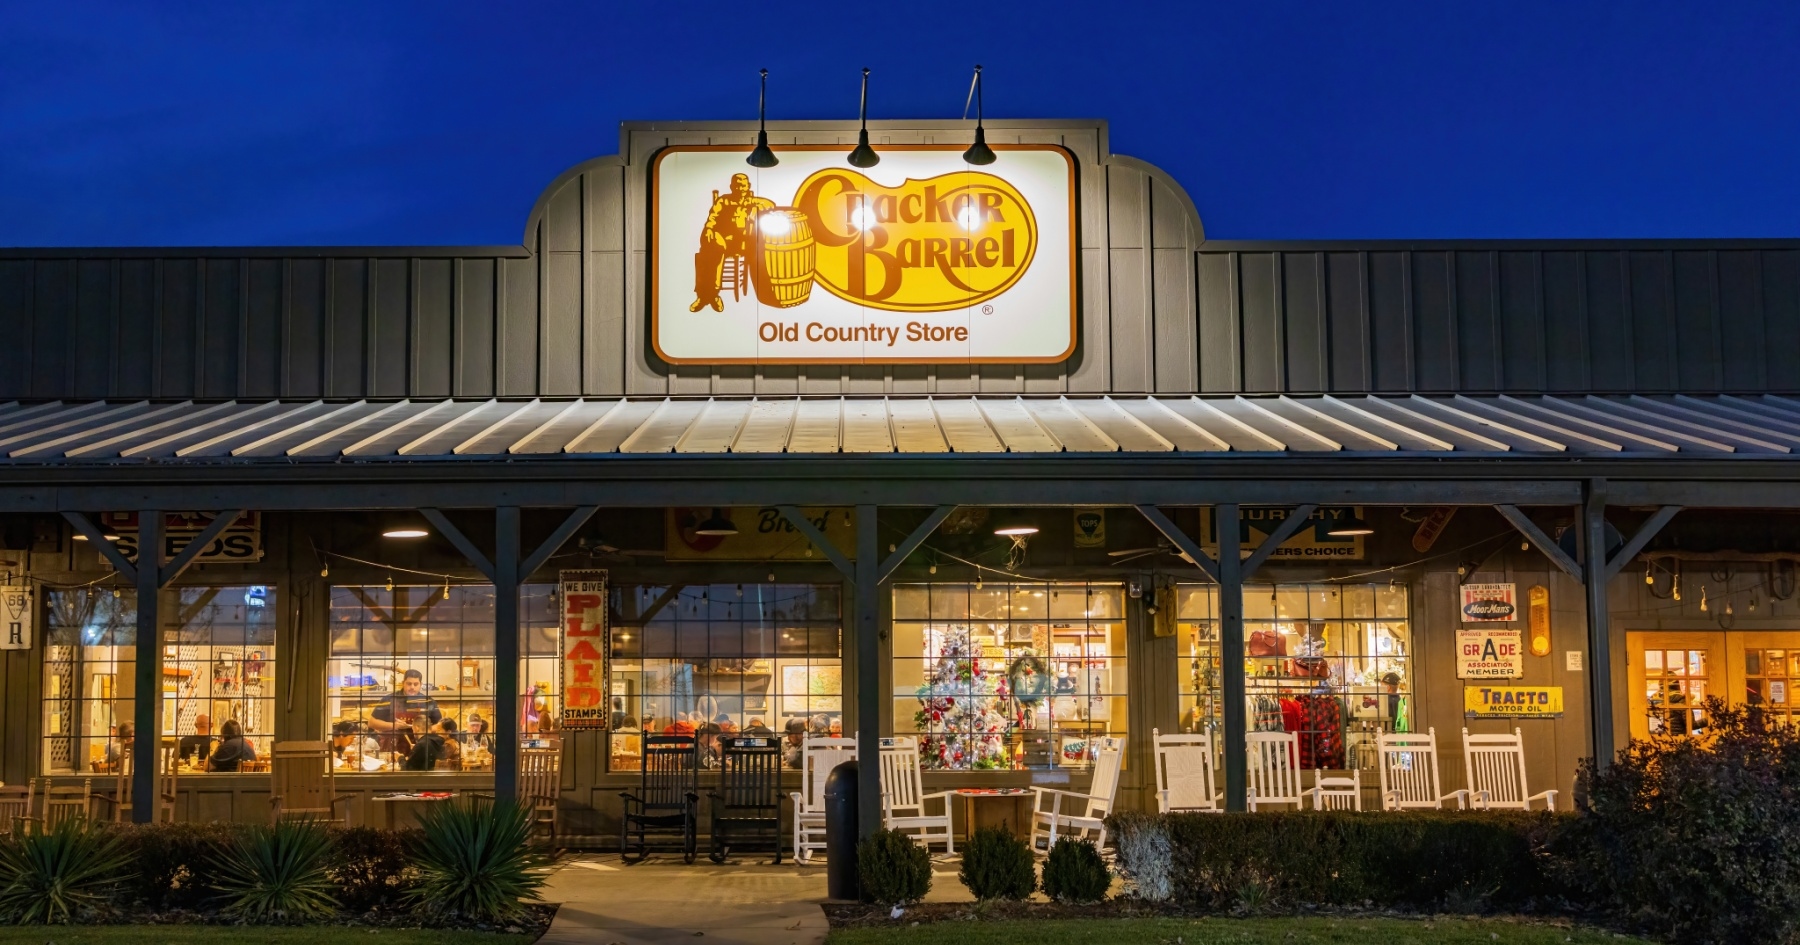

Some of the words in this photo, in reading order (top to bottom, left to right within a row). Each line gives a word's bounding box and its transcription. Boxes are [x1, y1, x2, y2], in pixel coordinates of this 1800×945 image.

[799, 174, 1006, 247] Cracker
[847, 227, 1016, 301] Barrel
[758, 321, 799, 342] Old
[805, 321, 901, 347] Country
[906, 321, 969, 342] Store
[757, 508, 829, 533] Bred
[1080, 519, 1098, 528] TOPS
[1240, 509, 1342, 520] URHY
[114, 535, 253, 558] SEDS
[1305, 547, 1356, 556] CHOICE
[565, 582, 579, 592] WE
[566, 594, 601, 707] PLAID
[1480, 688, 1549, 705] TRACTO
[564, 709, 603, 718] STAMPS
